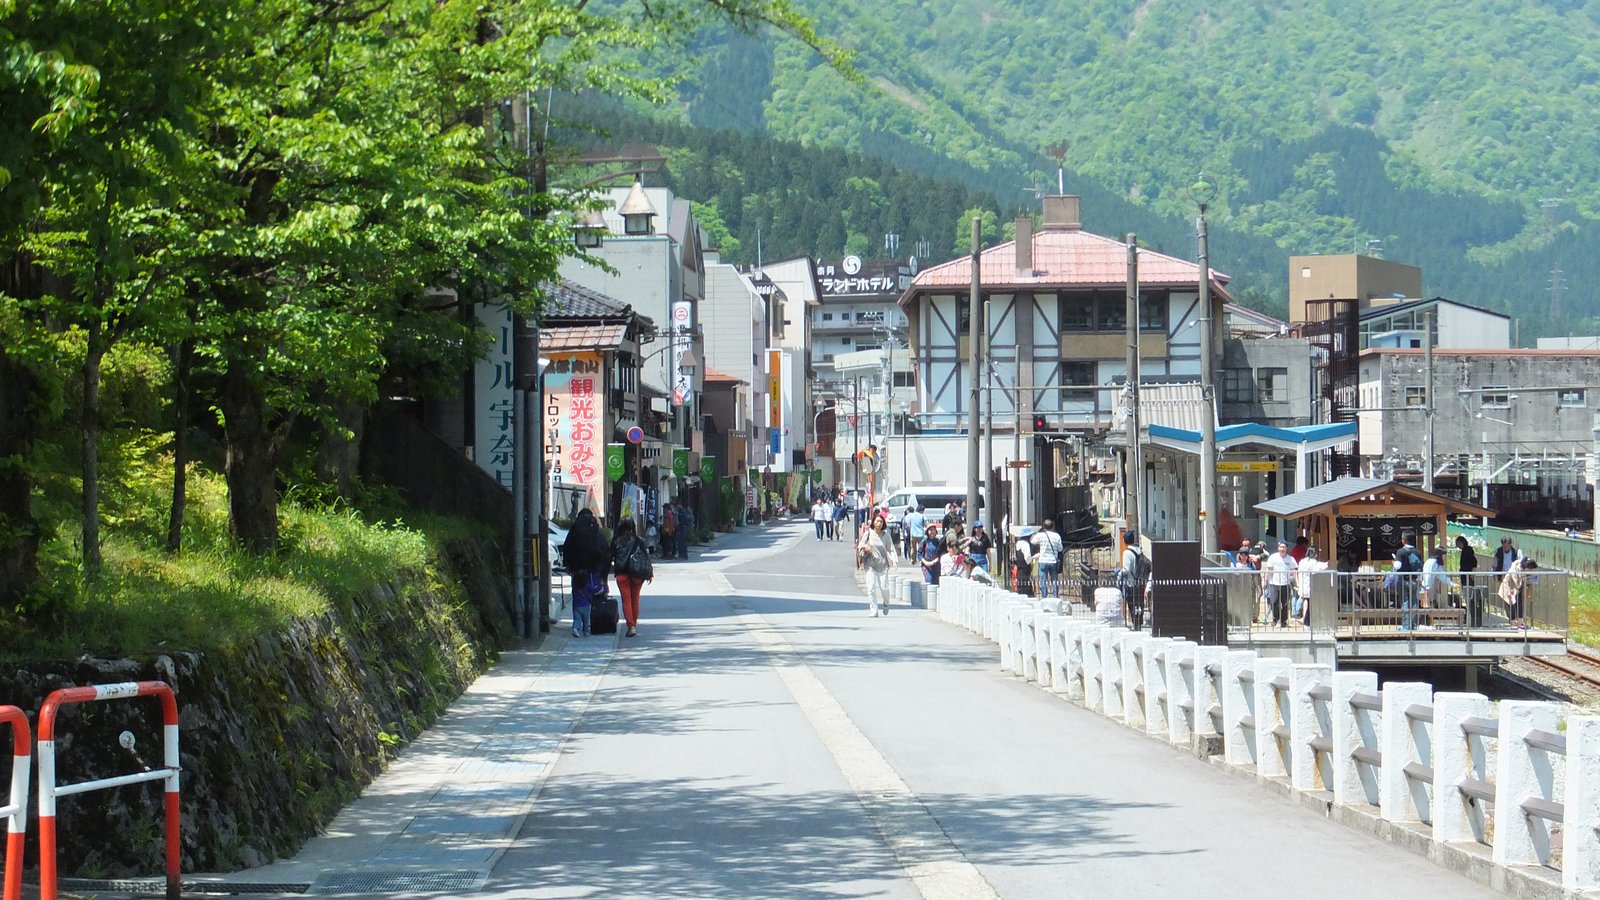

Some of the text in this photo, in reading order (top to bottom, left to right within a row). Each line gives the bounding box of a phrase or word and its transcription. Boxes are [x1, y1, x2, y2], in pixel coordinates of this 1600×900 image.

[818, 277, 894, 292] ランドホテル
